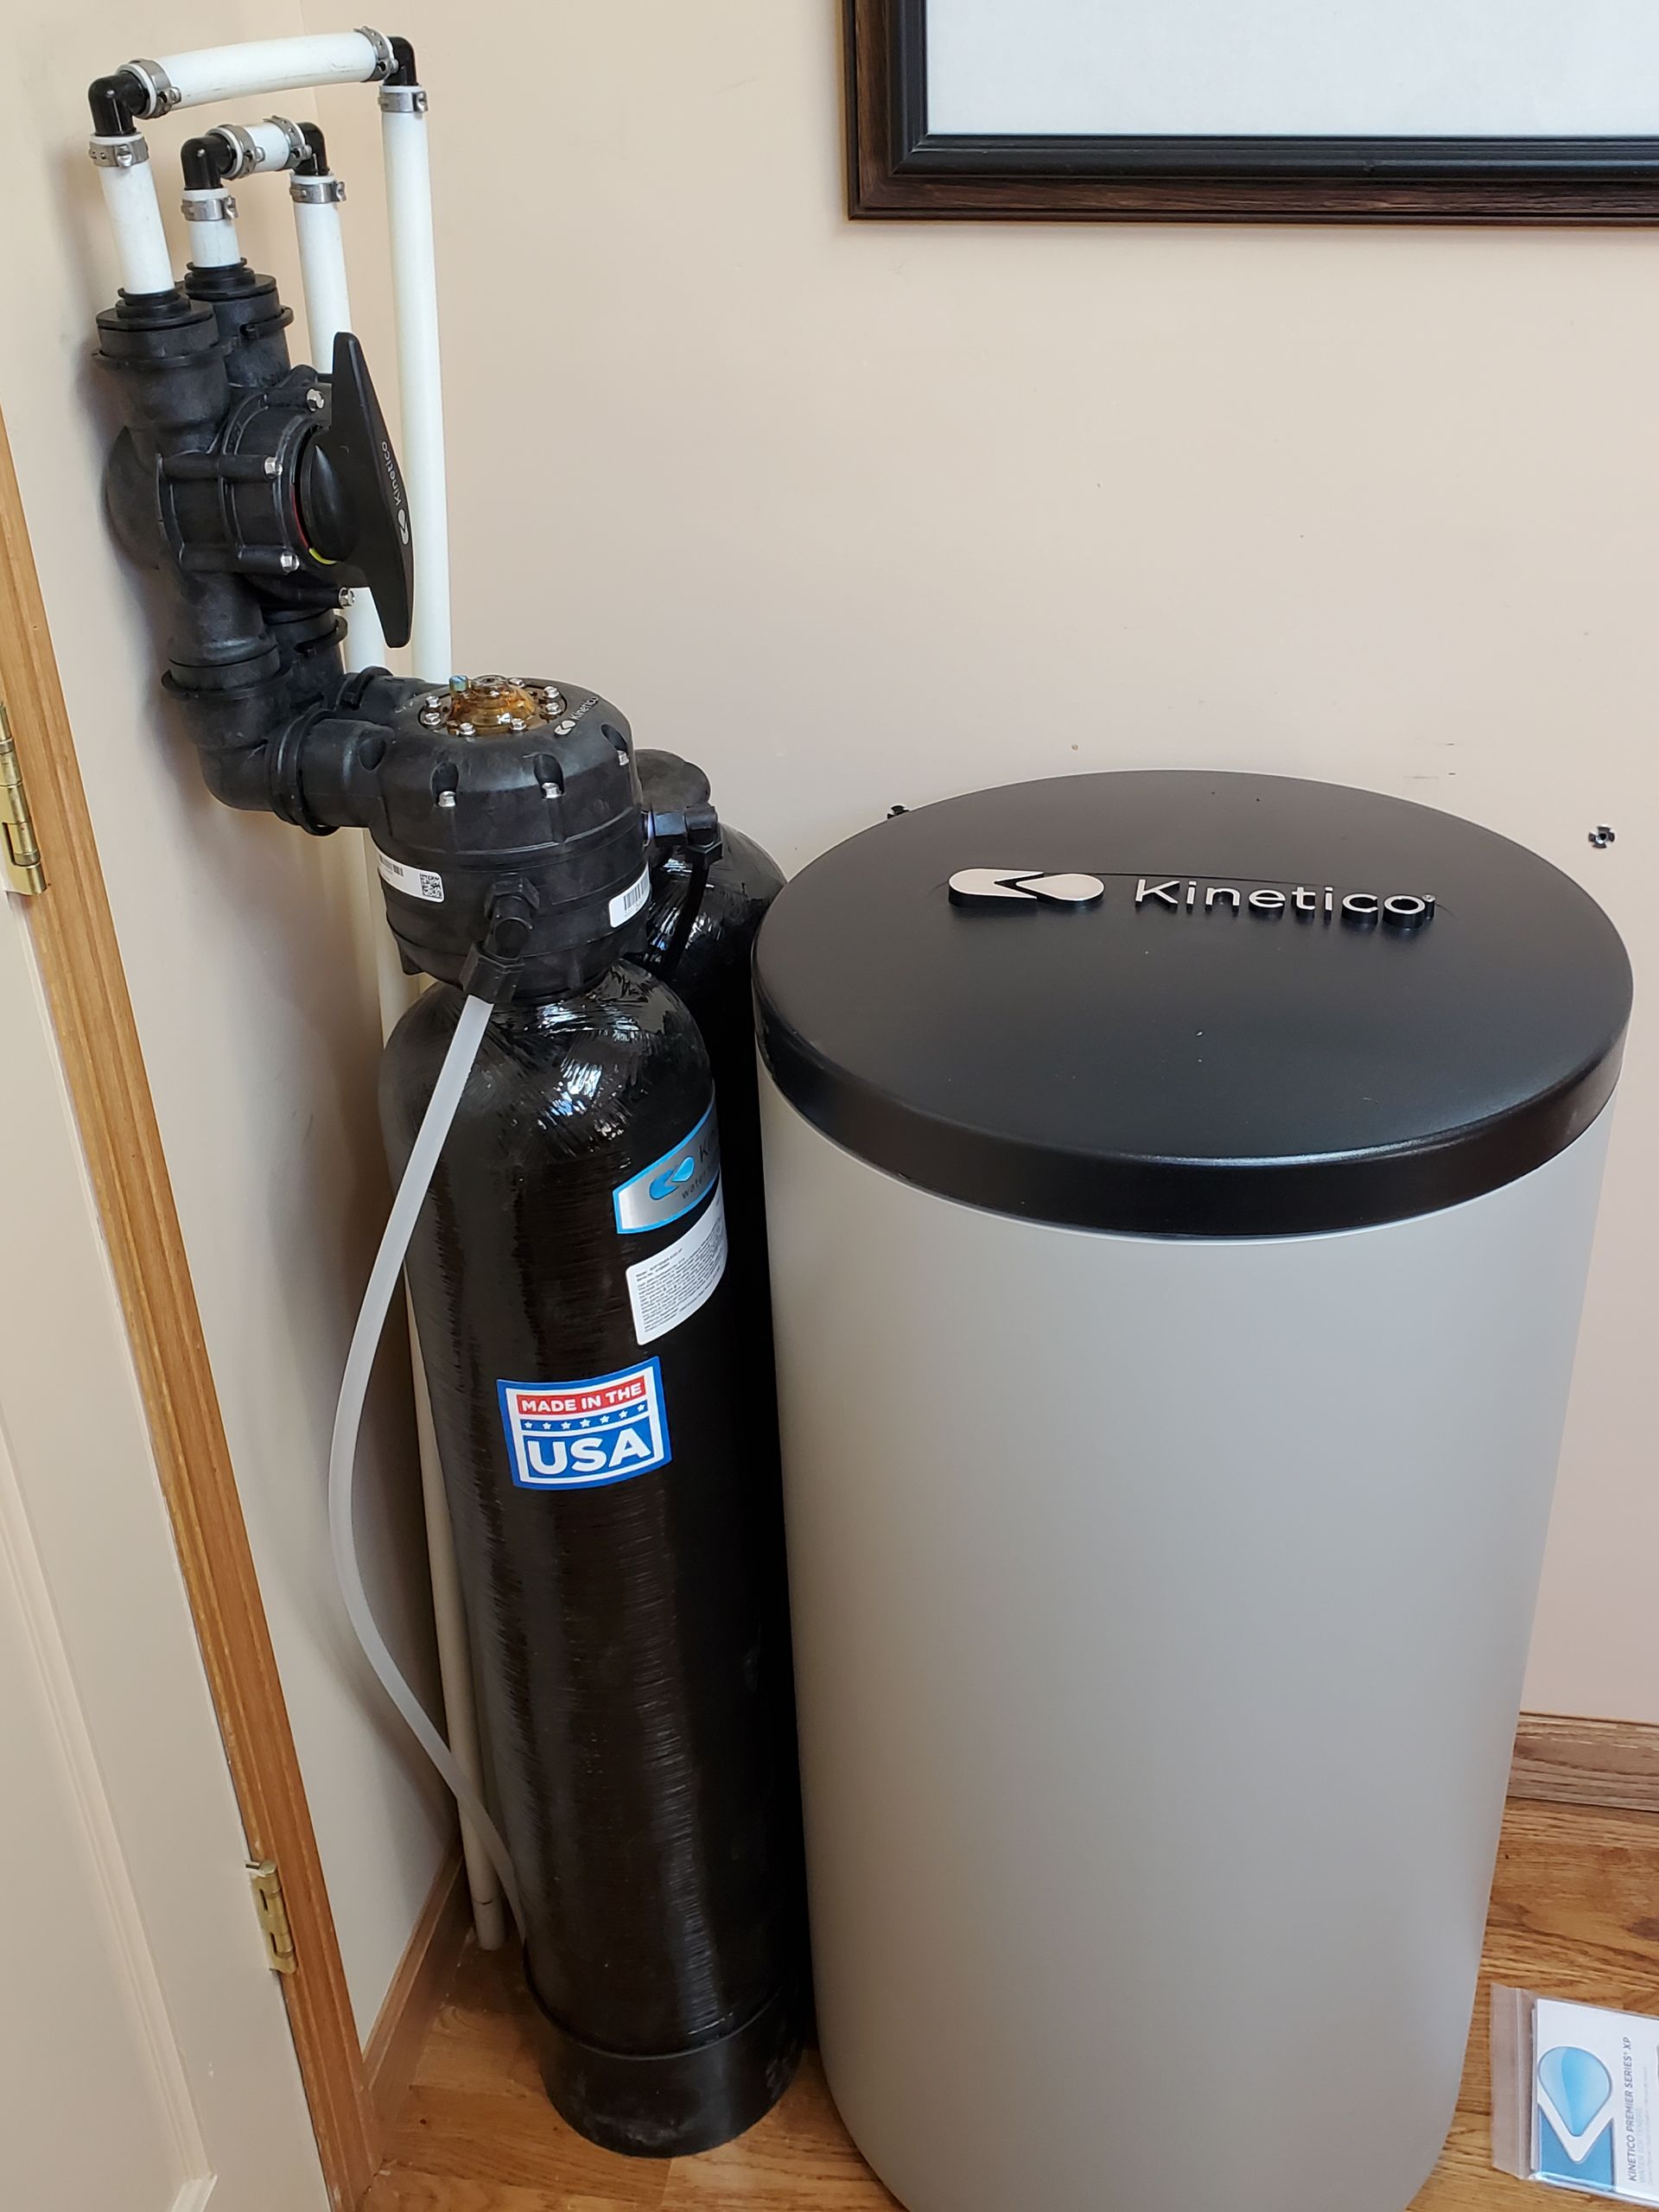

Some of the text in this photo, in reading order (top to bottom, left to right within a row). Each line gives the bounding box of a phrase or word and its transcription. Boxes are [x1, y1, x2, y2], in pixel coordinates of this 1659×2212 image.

[381, 441, 402, 506] Kinetico
[1135, 878, 1426, 916] Kinetico
[521, 1382, 642, 1413] MADE IN THE
[526, 1427, 652, 1475] USA
[1623, 2036, 1632, 2050] XP
[1625, 2089, 1637, 2133] PREMIER
[1626, 2134, 1637, 2182] KINETICO
